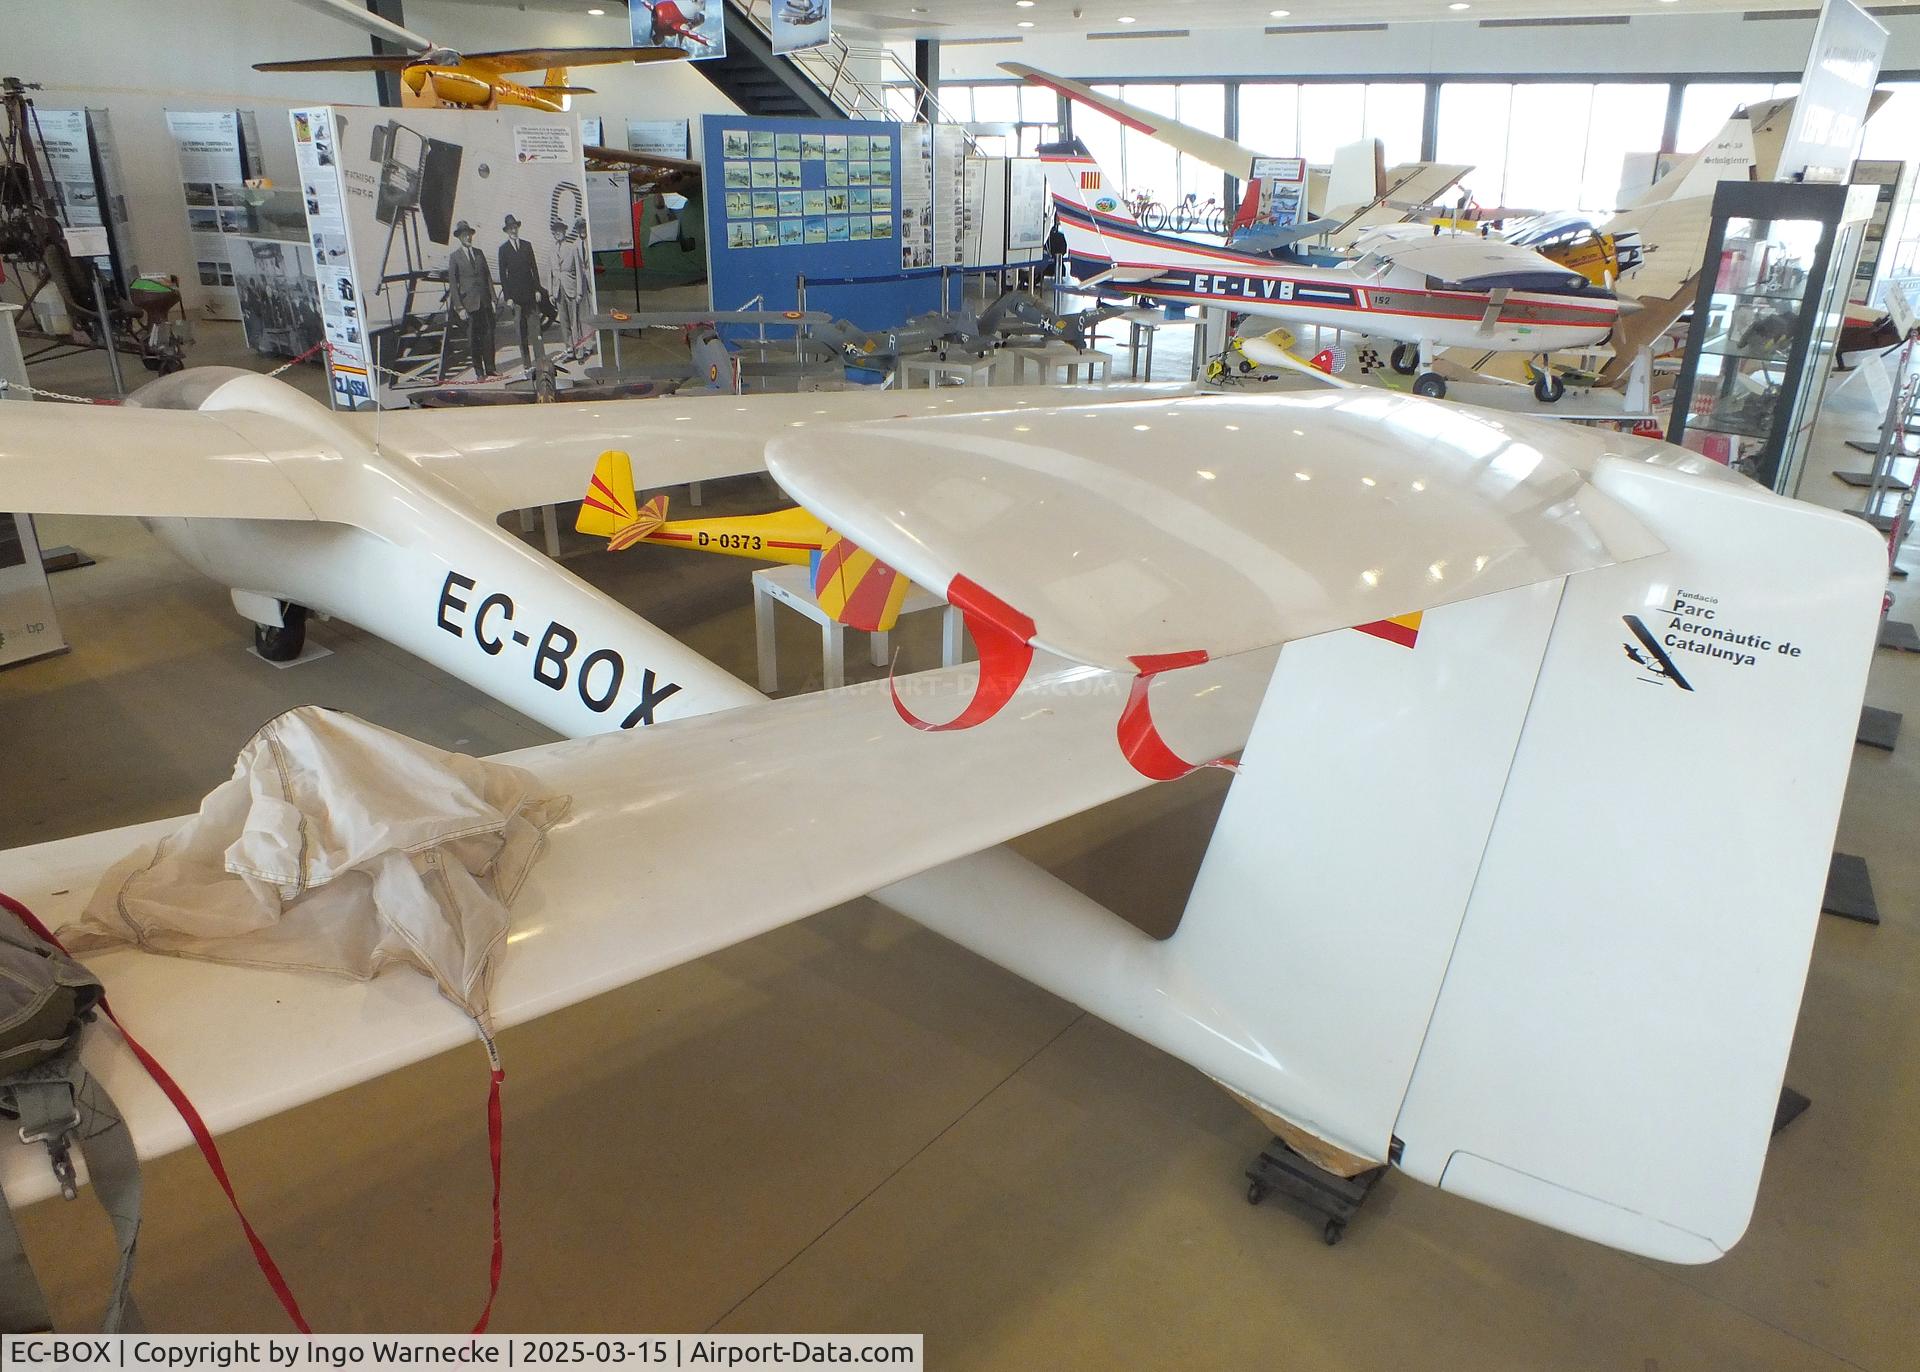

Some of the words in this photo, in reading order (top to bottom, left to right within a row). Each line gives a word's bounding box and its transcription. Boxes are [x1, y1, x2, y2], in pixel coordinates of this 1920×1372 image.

[1194, 274, 1295, 300] EC-LVB
[698, 531, 762, 550] D-0373
[1672, 599, 1716, 620] Parc
[1676, 589, 1719, 605] Fundació
[437, 571, 682, 729] EC-BOX
[1664, 634, 1756, 666] Catalunya
[1668, 617, 1772, 651] Aeronàutic
[1777, 642, 1801, 658] de
